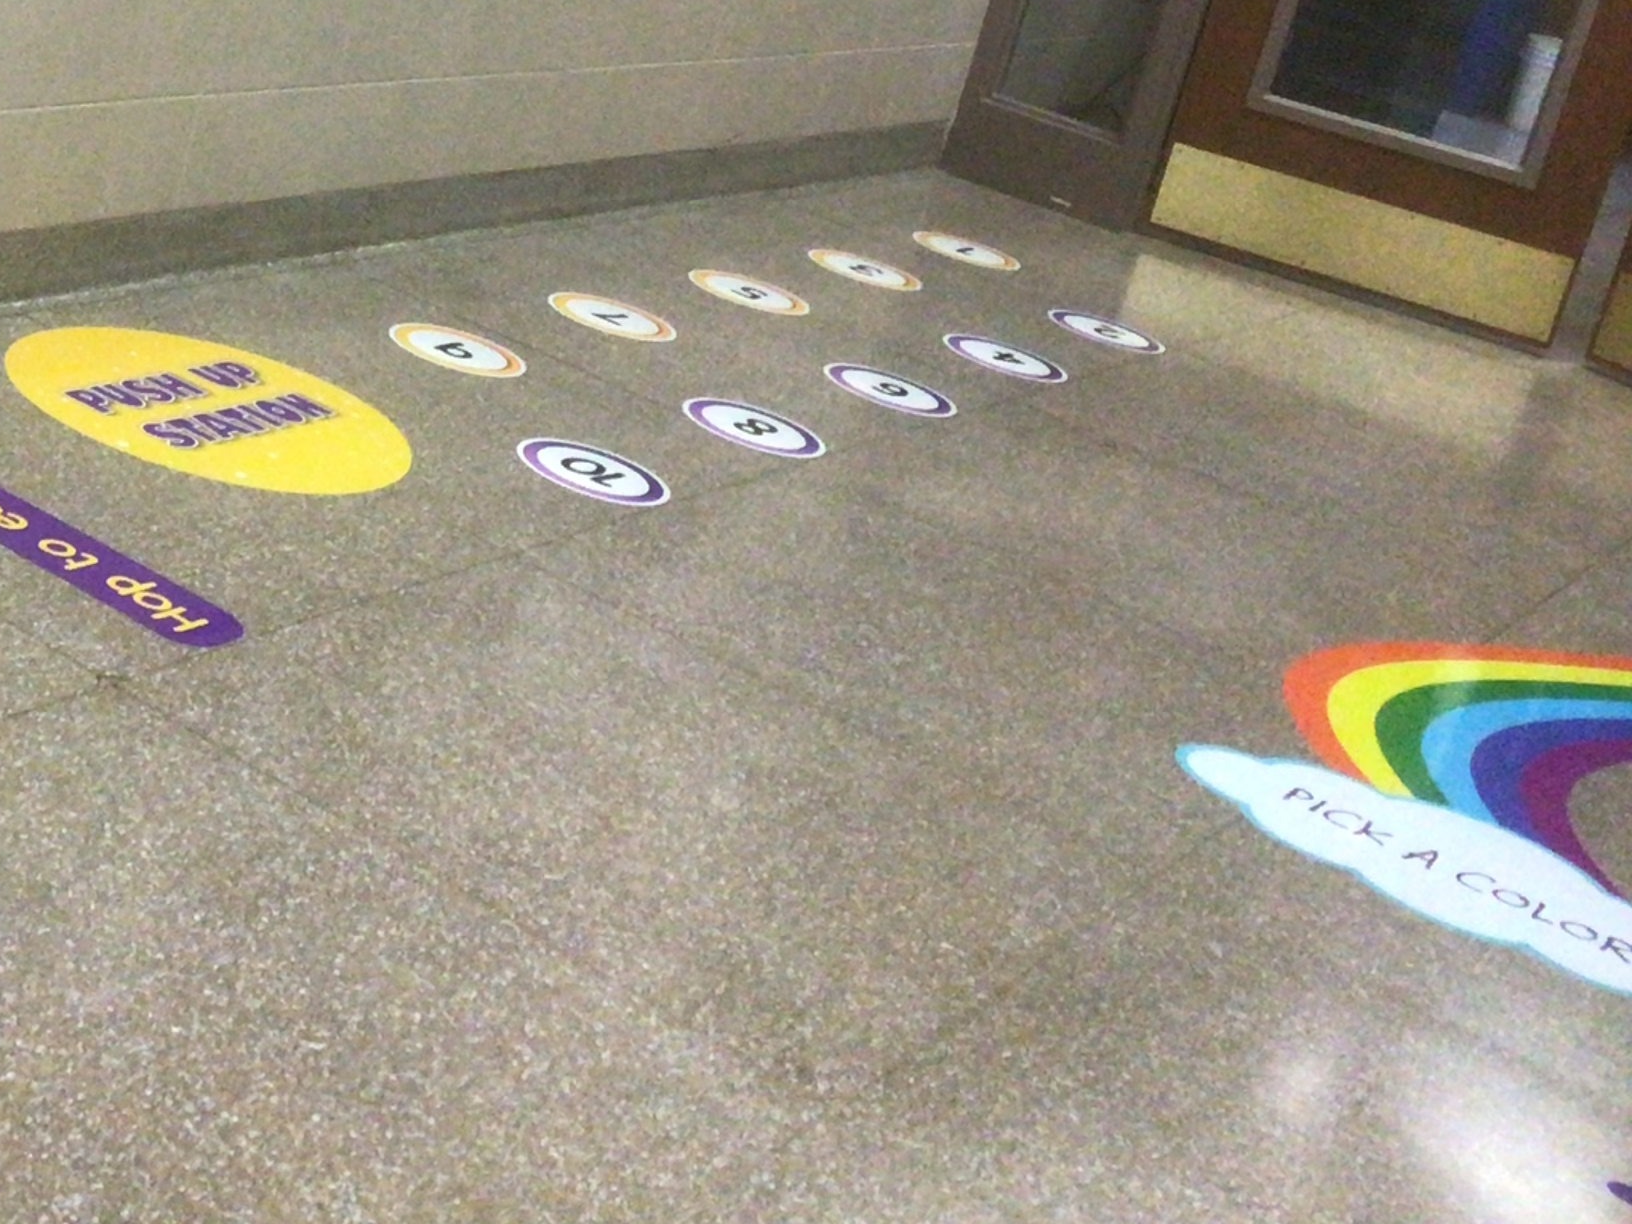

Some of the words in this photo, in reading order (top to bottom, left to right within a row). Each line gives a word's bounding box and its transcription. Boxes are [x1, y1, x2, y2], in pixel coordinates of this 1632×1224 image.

[730, 286, 768, 300] 5
[591, 313, 629, 326] 7
[433, 341, 474, 359] 9
[992, 350, 1026, 364] 4
[64, 372, 207, 414] PUSH
[189, 361, 262, 389] UP
[871, 382, 909, 398] 6
[141, 393, 335, 448] STATION
[732, 418, 779, 436] 8
[560, 457, 626, 488] 10
[37, 538, 99, 571] to
[105, 576, 209, 633] Hop
[1282, 787, 1394, 847] PICK
[1401, 849, 1439, 869] A
